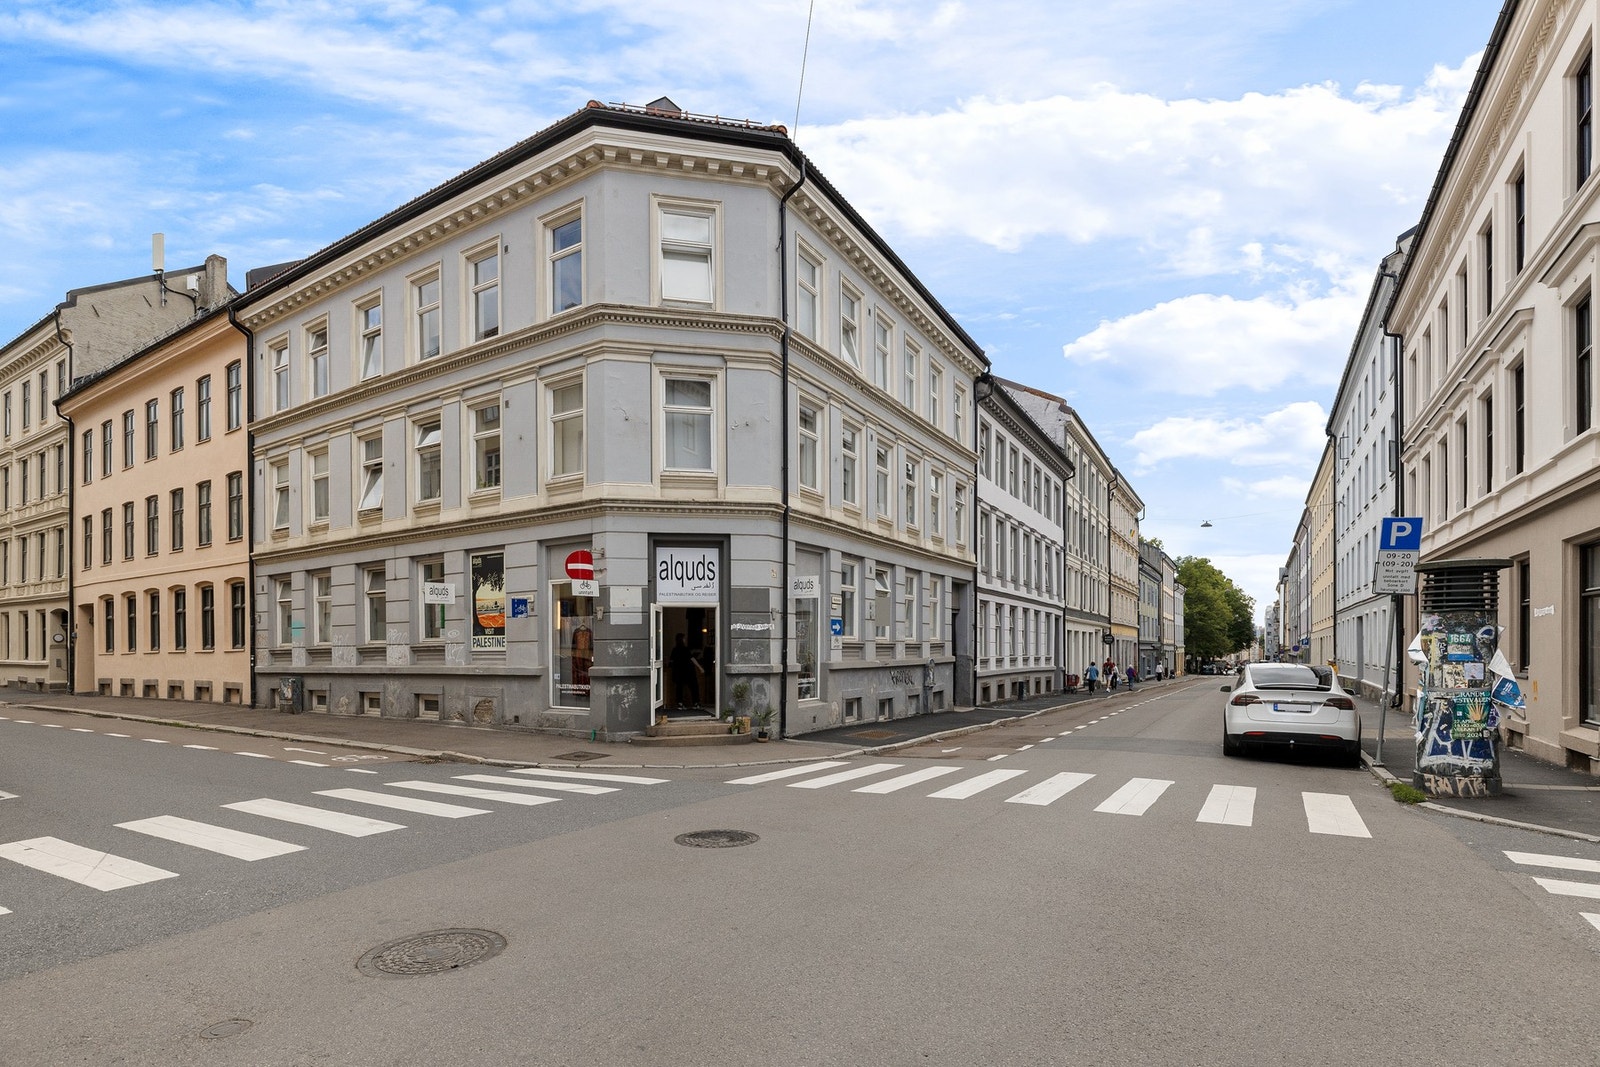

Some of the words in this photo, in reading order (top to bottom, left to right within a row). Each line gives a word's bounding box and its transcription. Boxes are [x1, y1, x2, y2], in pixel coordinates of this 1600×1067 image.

[1390, 522, 1412, 546] P
[659, 554, 716, 588] alquds
[429, 585, 449, 598] alquds
[794, 580, 814, 592] alquds
[473, 637, 505, 648] PALESTINE
